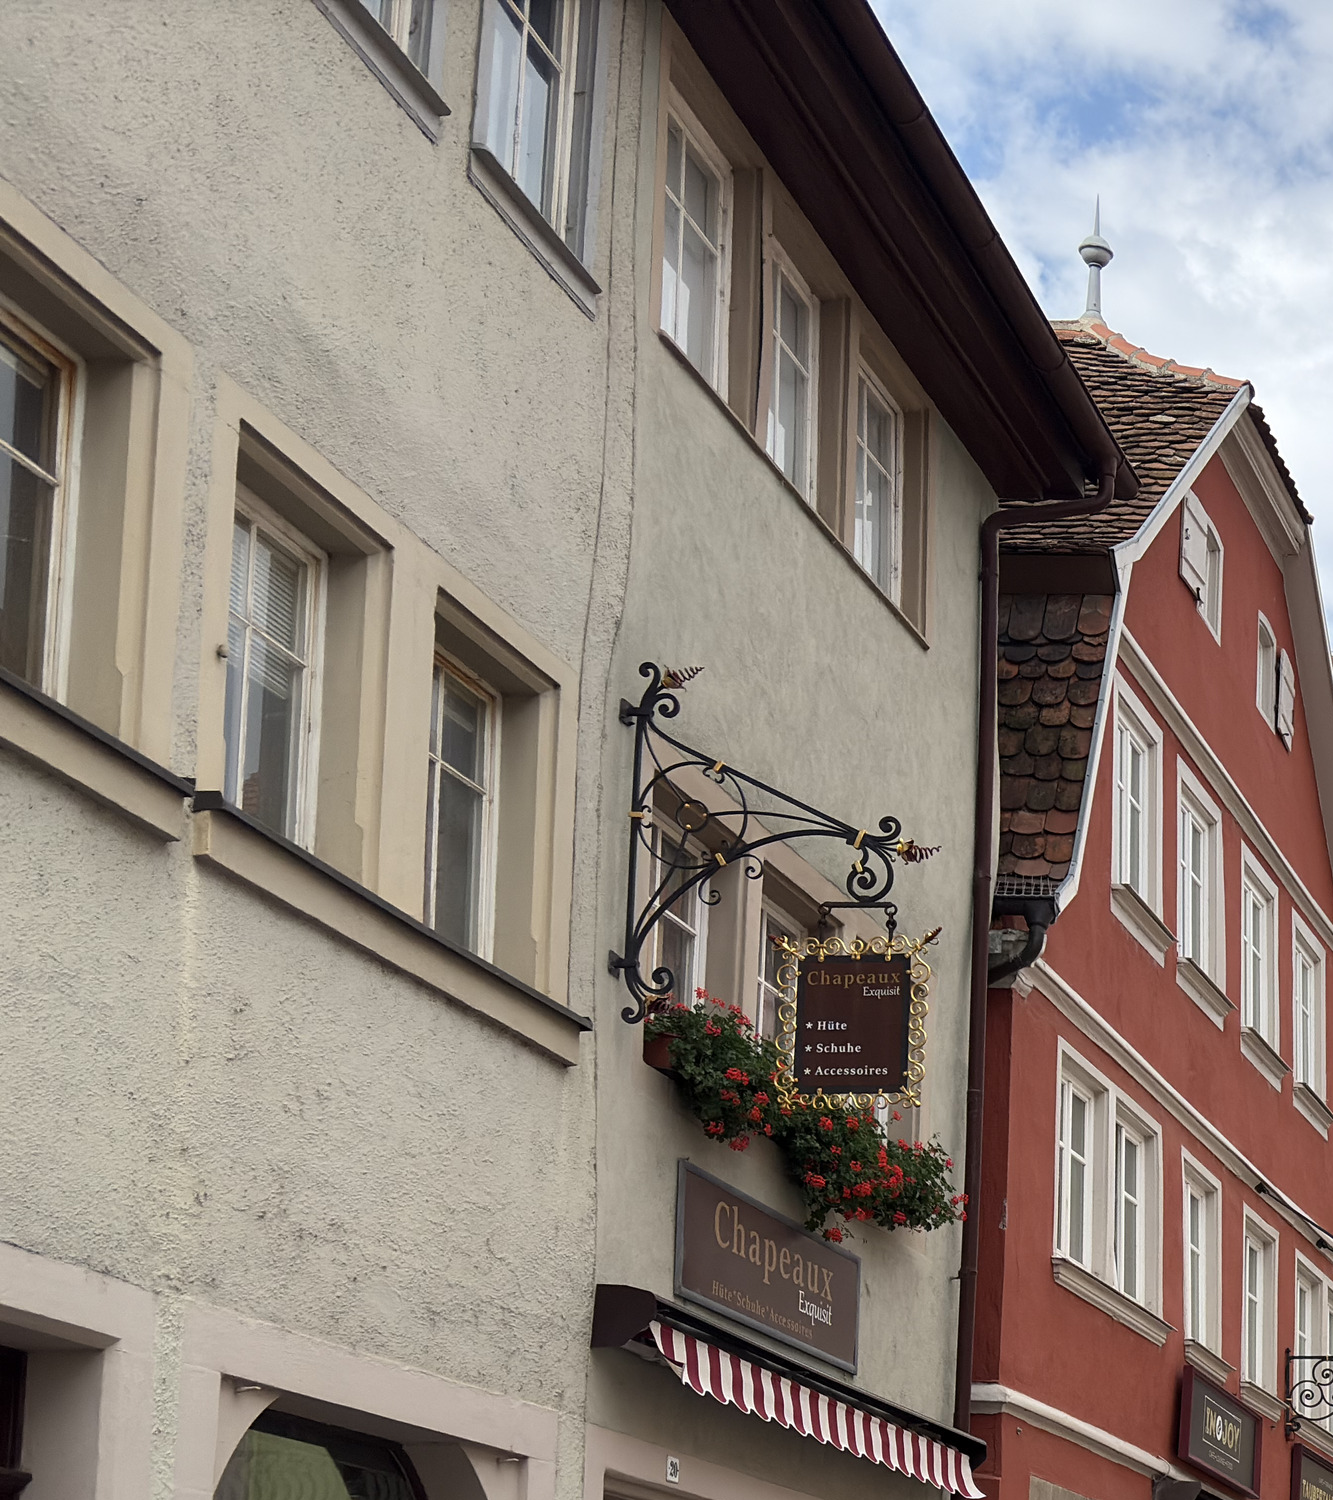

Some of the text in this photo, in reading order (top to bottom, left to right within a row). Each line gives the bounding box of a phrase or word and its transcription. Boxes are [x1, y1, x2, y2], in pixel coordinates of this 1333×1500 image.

[807, 970, 900, 989] Chapeaux
[863, 986, 901, 999] Exquisit
[816, 1020, 848, 1031] Hüte
[815, 1042, 862, 1053] Schuhe
[814, 1065, 888, 1076] Accessoires
[714, 1200, 834, 1301] Chapeaux
[798, 1289, 833, 1327] Exquisit
